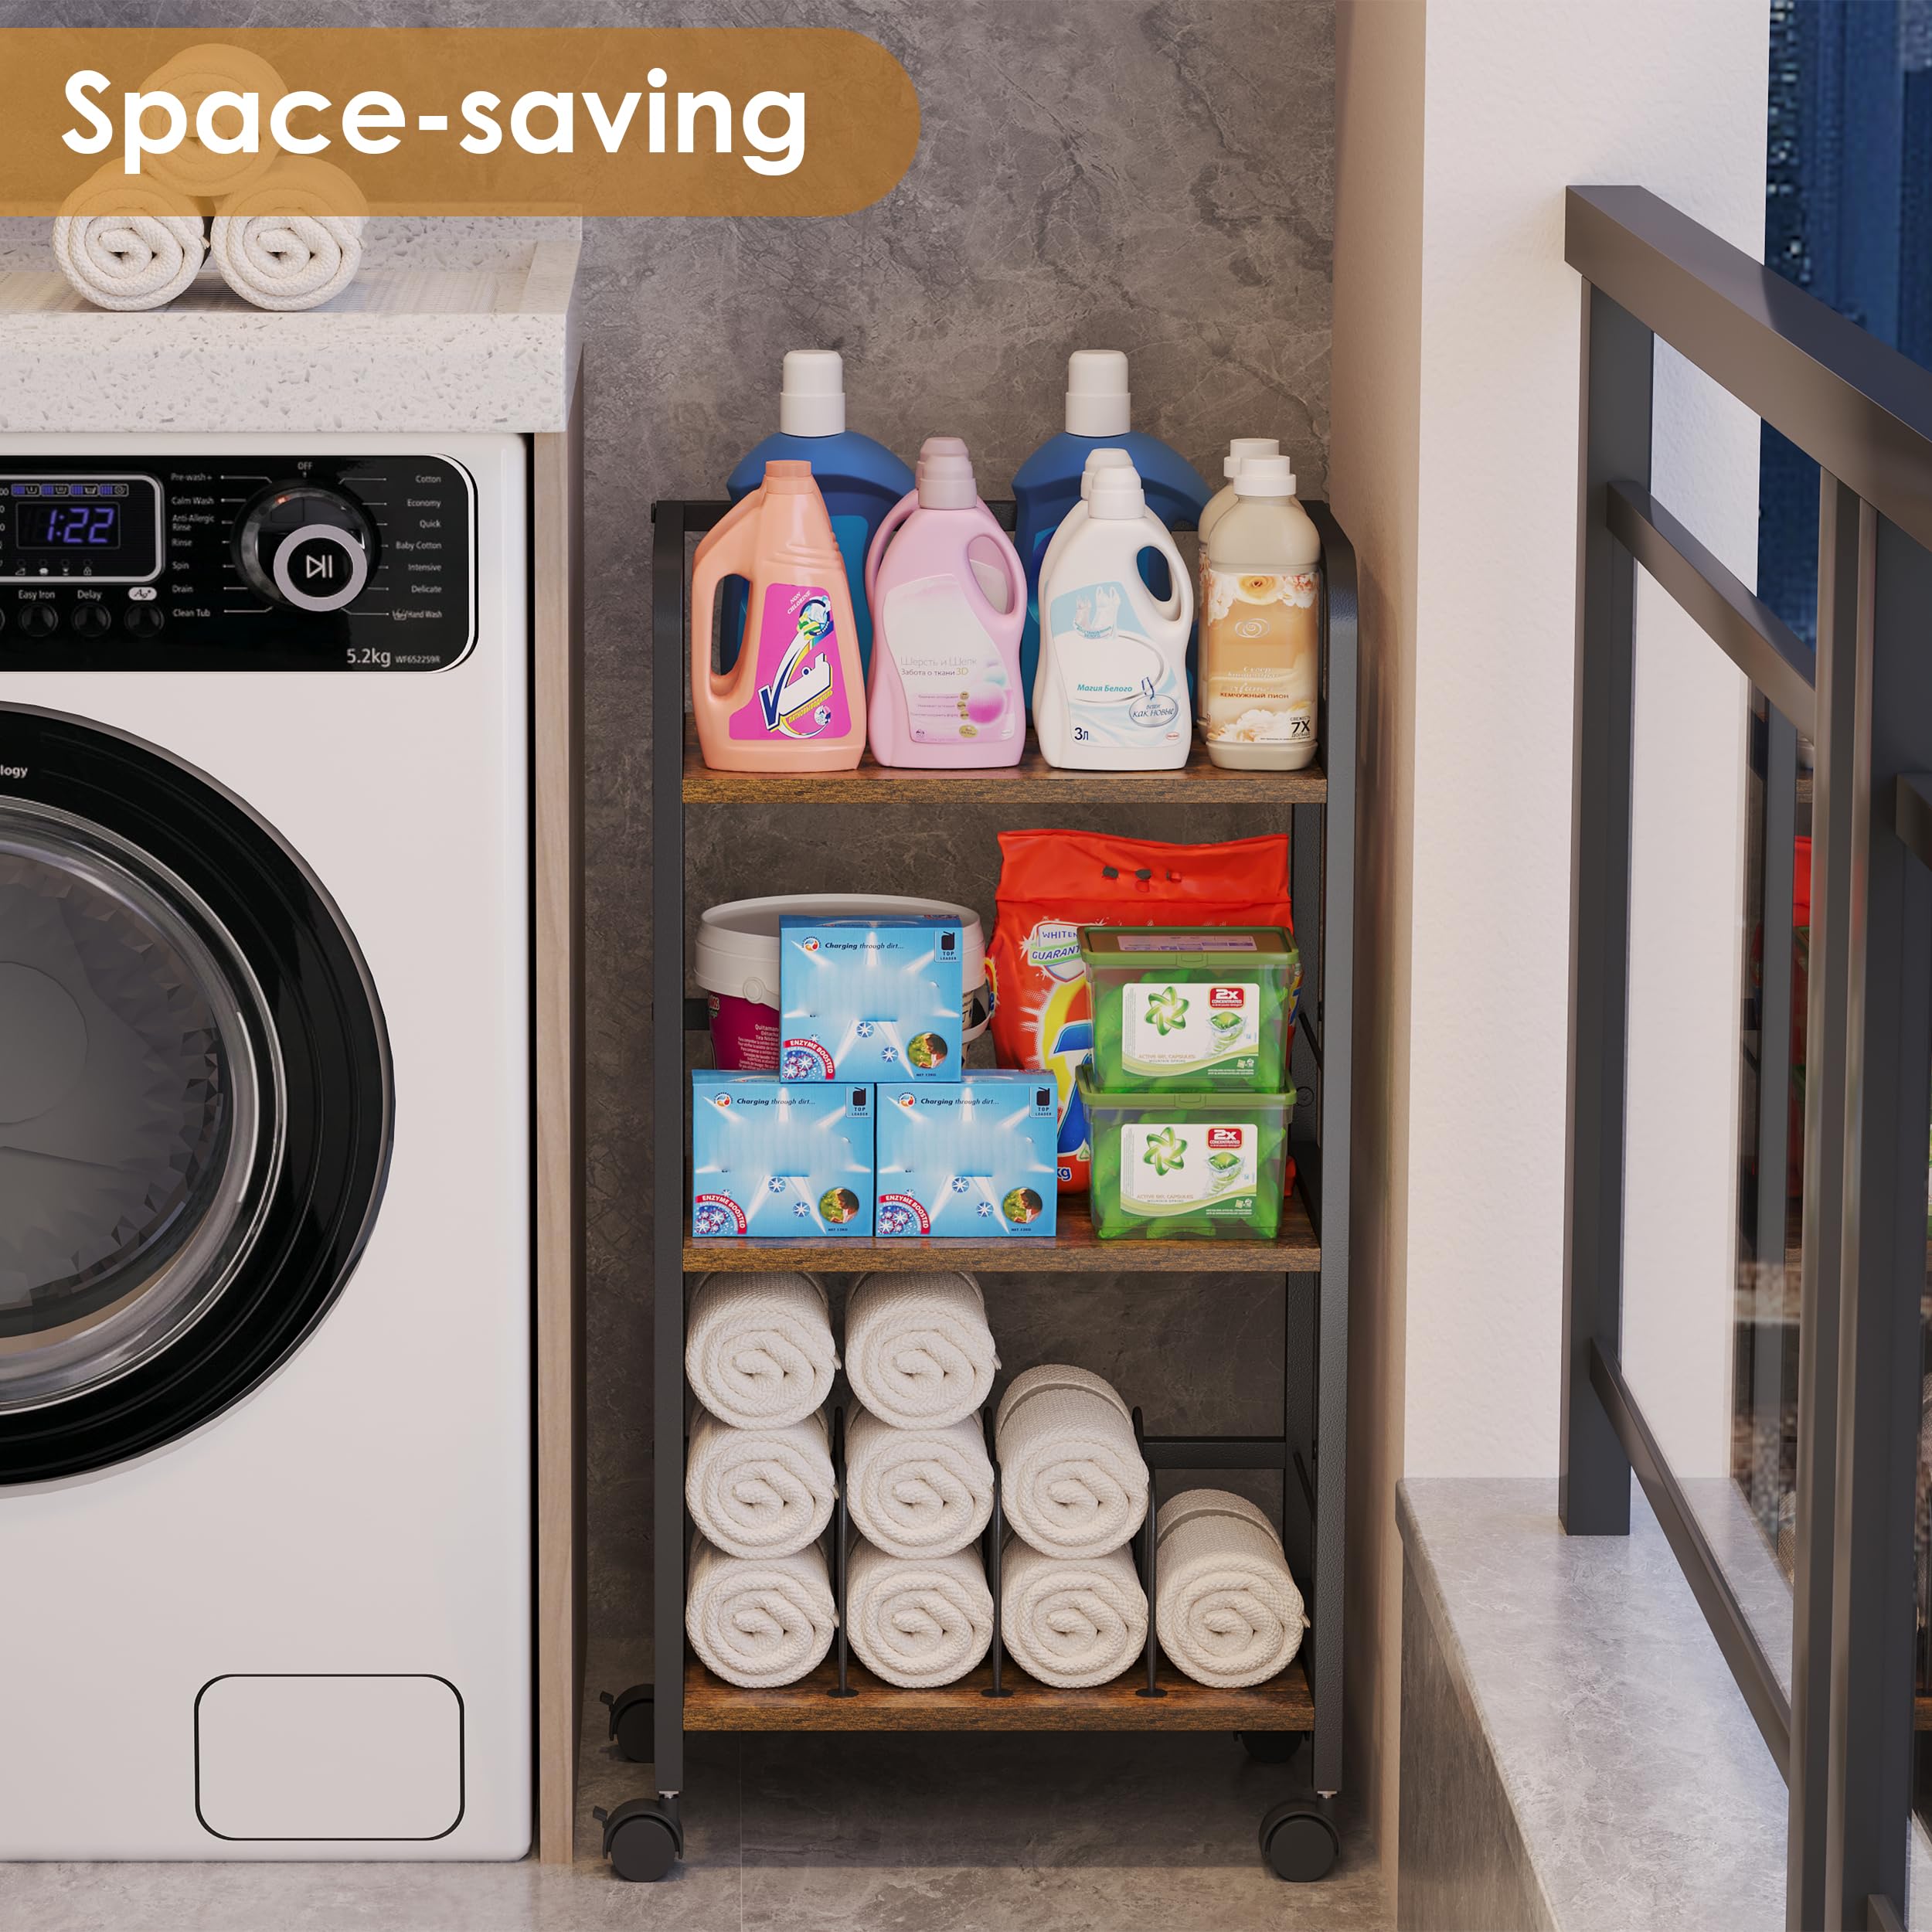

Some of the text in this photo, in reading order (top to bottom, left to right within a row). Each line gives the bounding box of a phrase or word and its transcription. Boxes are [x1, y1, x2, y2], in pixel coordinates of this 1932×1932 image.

[171, 496, 214, 505] Calm Wash
[407, 499, 441, 509] Economy
[172, 514, 215, 524] Anti-Allergic
[420, 519, 441, 529] Quick
[47, 508, 114, 543] 1:22
[396, 542, 415, 551] Baby
[172, 562, 189, 570] Spin
[408, 563, 442, 571] Intensive
[172, 585, 193, 594] Drain
[411, 585, 442, 594] Delicate
[19, 590, 56, 600] Easy Iron
[77, 590, 103, 601] Delay
[790, 591, 801, 604] NON
[196, 608, 210, 617] Tub
[347, 648, 391, 668] 5.2kg
[900, 668, 926, 676] Забота
[1077, 684, 1133, 693] Магия Белого
[1074, 726, 1089, 740] 3л
[825, 941, 857, 950] Charging
[1216, 989, 1239, 999] 2x
[790, 1039, 834, 1073] ENZYME BOOSTED
[1214, 1129, 1237, 1140] 2x
[702, 1195, 746, 1229] ENZYME BOOSTED
[885, 1195, 929, 1229] ENZYME BOOSTED
